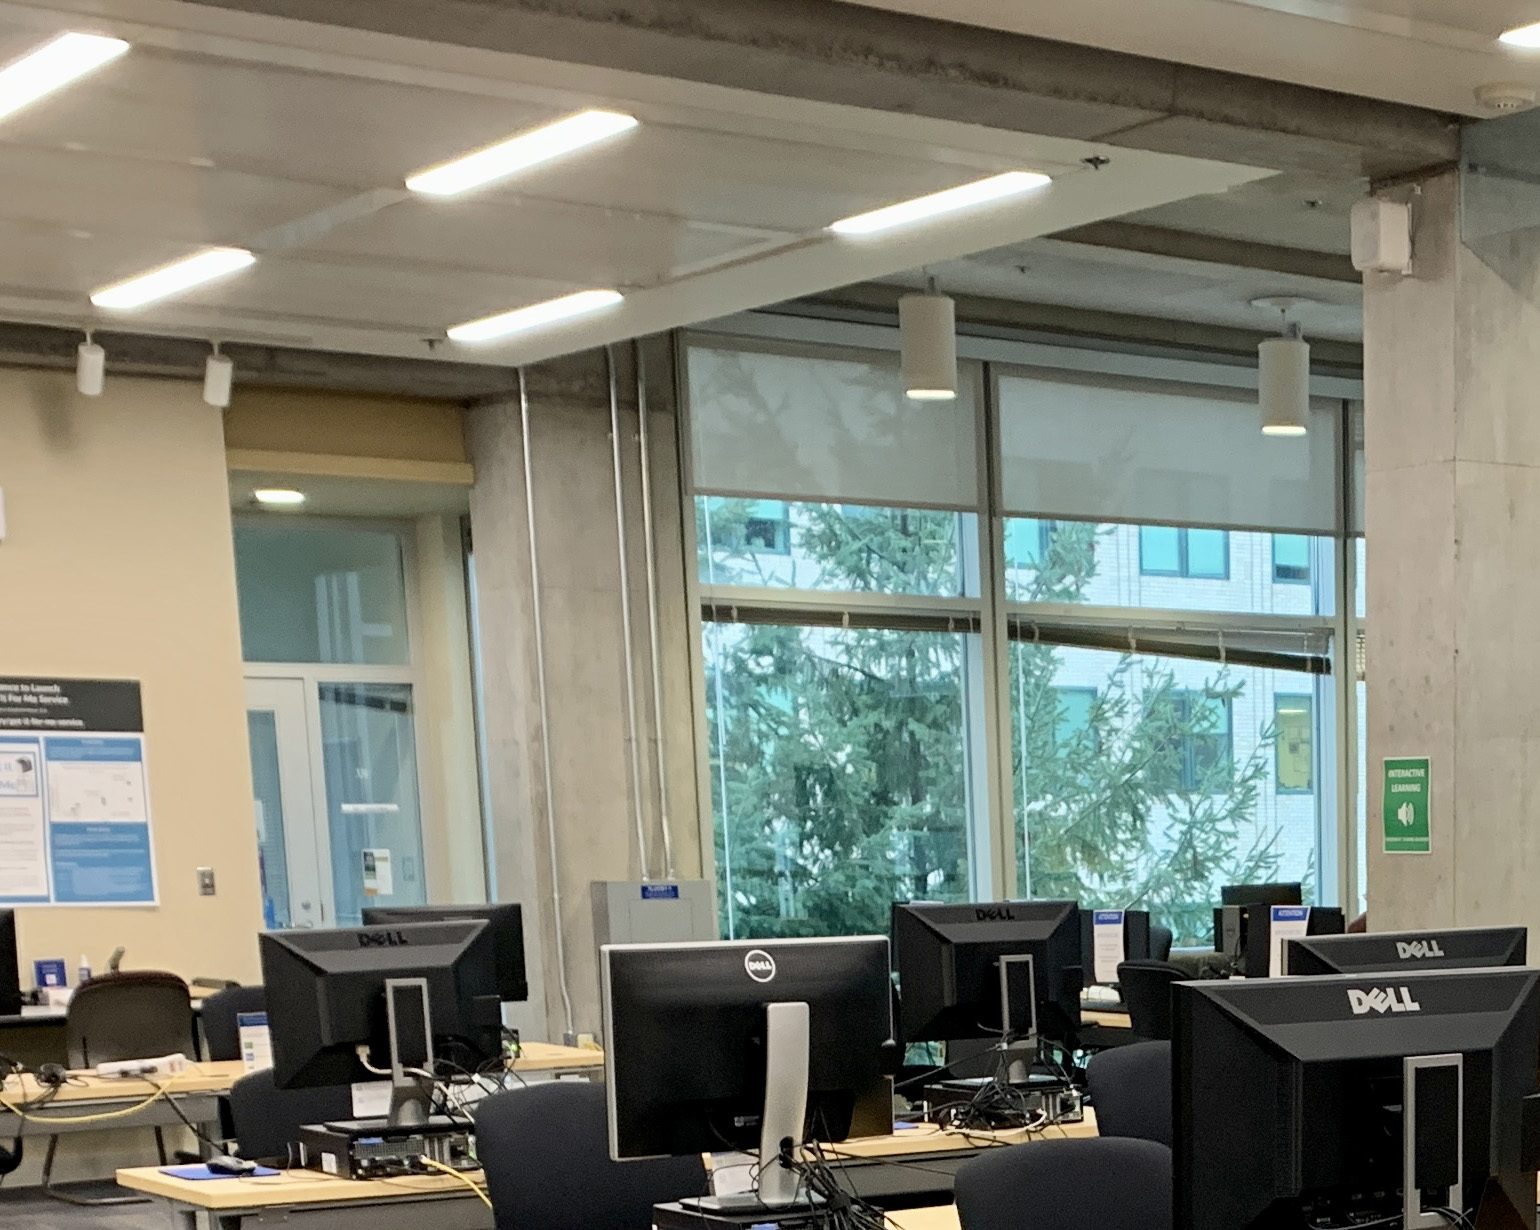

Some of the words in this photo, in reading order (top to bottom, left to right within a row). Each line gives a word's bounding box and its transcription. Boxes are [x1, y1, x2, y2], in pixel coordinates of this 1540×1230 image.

[1387, 769, 1425, 778] INTERACTIVE
[1391, 784, 1421, 793] LEARNING
[975, 908, 1015, 921] DELL
[357, 930, 409, 948] DELL
[1396, 940, 1445, 959] DELL
[748, 960, 773, 971] DELL
[1347, 987, 1421, 1015] DELL
